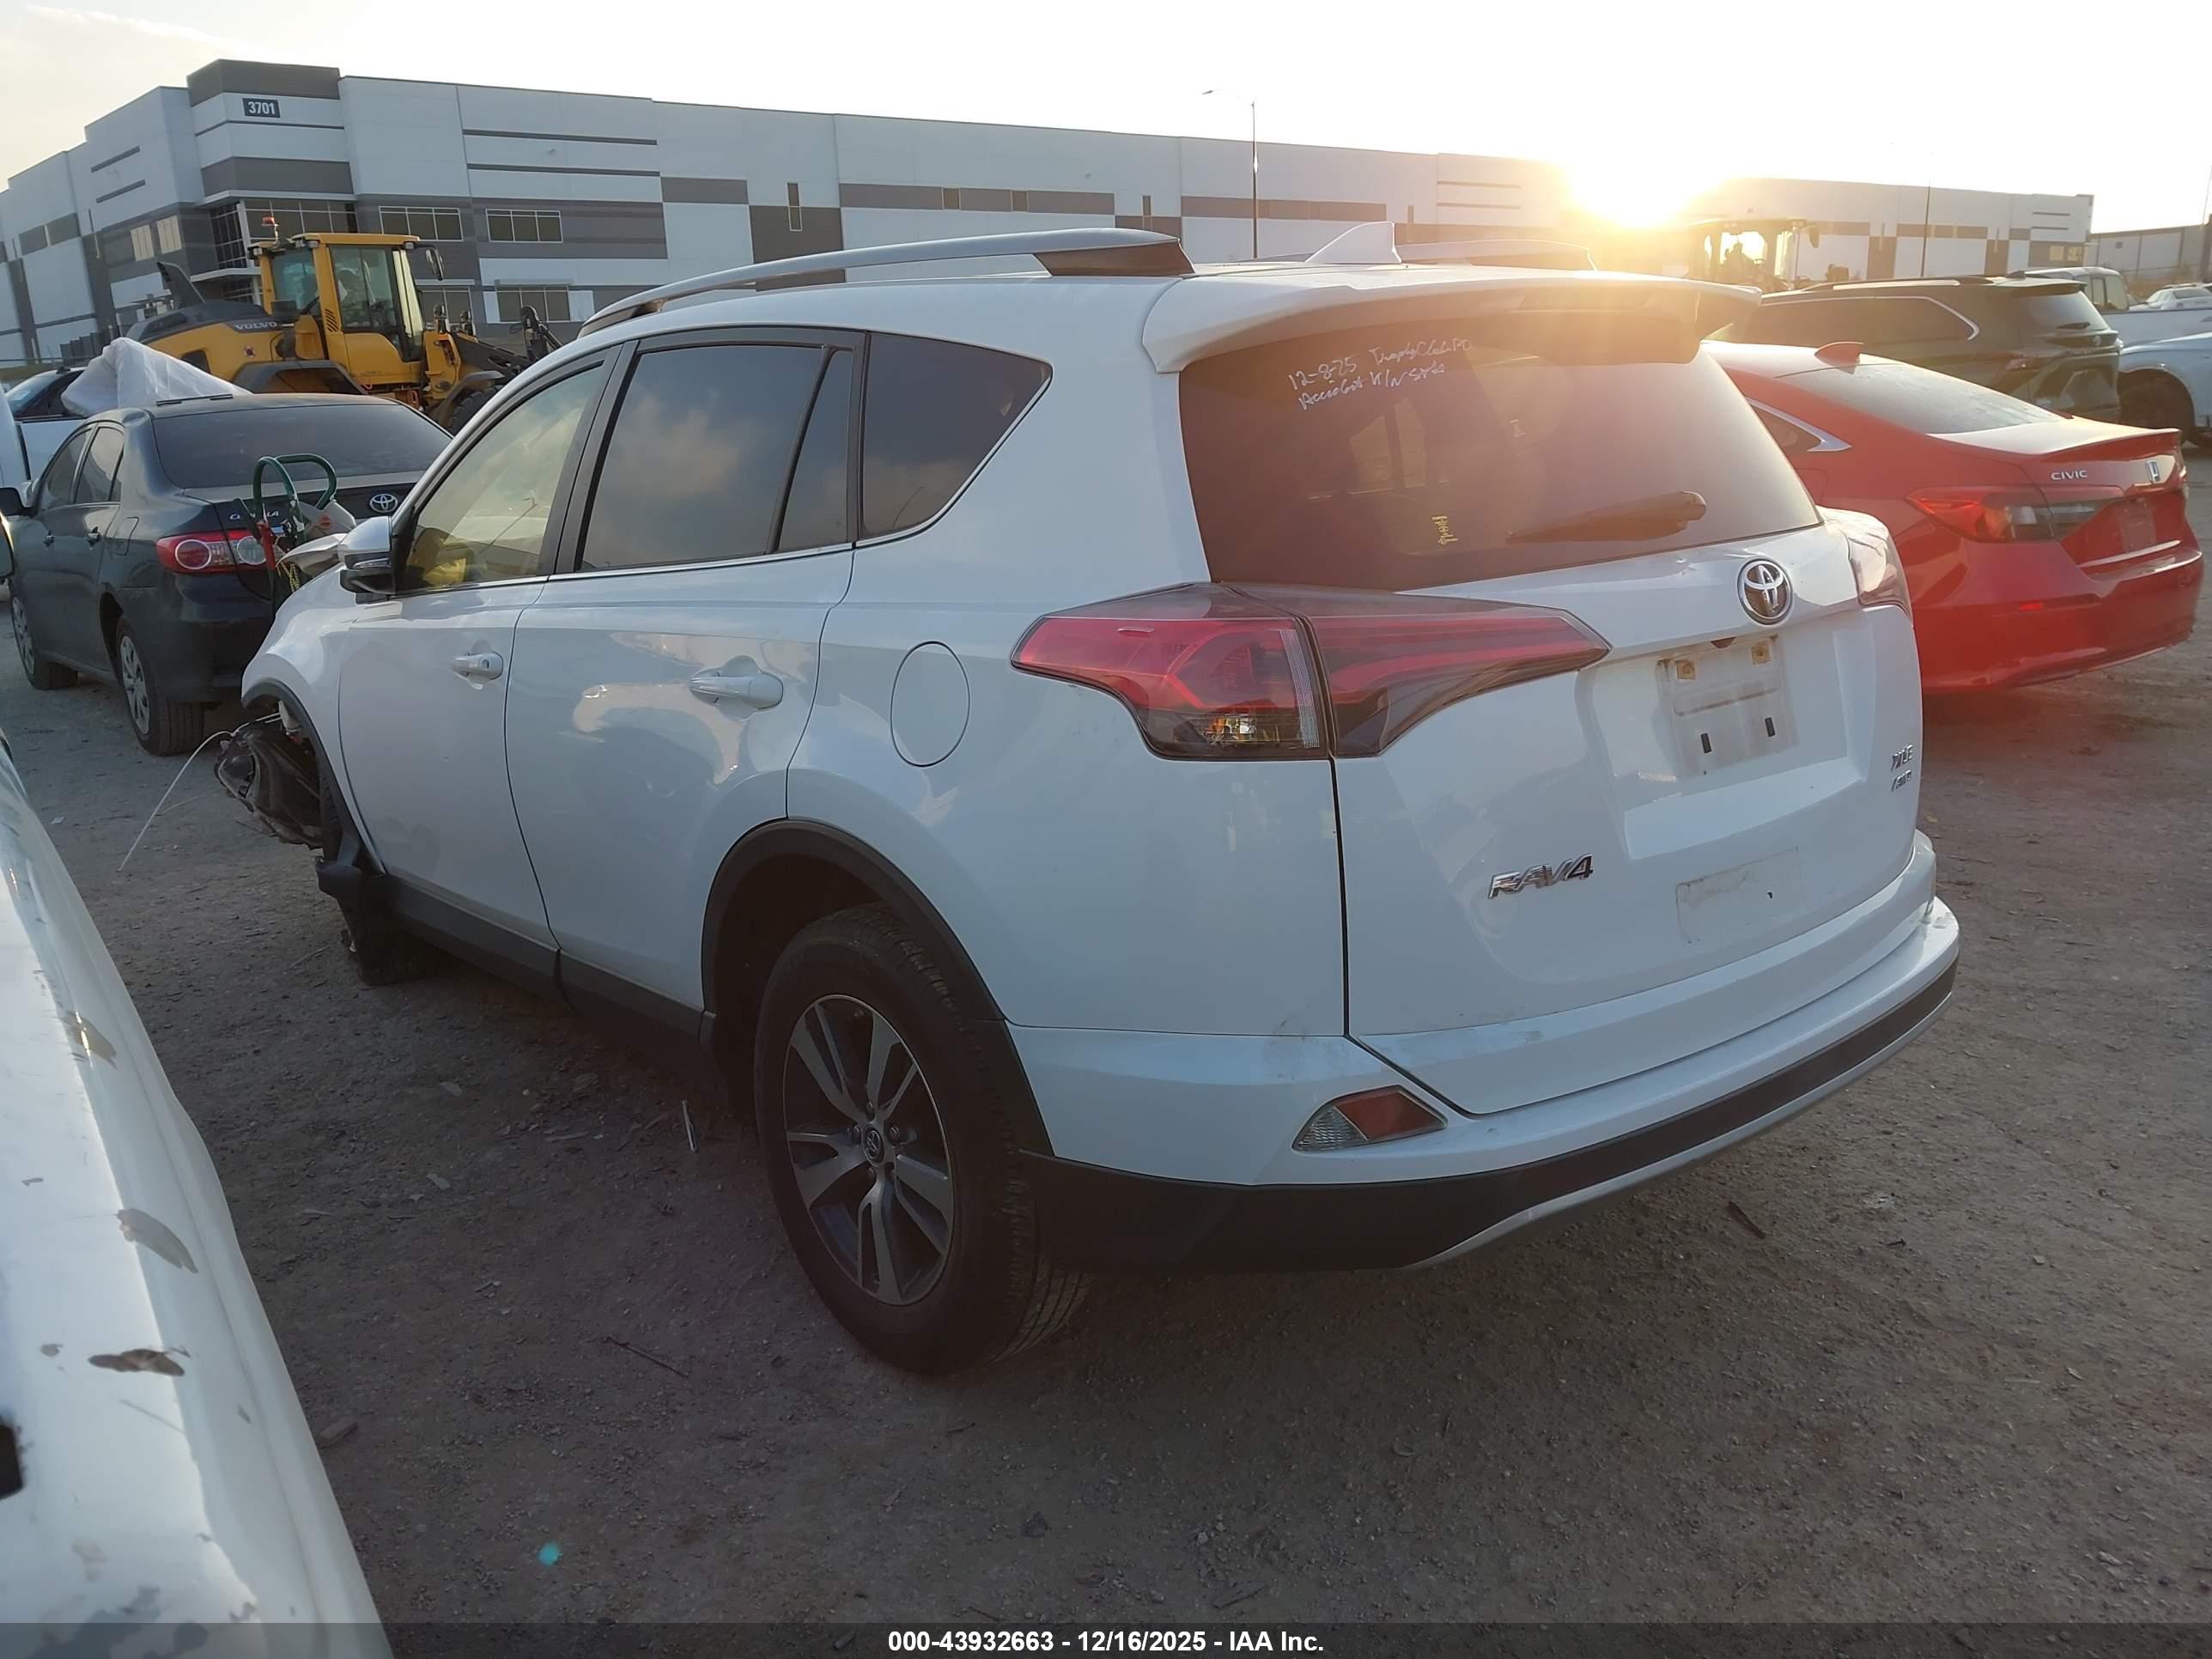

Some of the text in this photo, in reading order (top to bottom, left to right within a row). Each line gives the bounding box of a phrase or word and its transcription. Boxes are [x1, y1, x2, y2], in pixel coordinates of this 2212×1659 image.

[248, 101, 276, 115] 3701
[234, 321, 277, 330] VOLVO
[2051, 470, 2088, 480] CIVIC
[1890, 744, 1914, 772] XLE
[1488, 853, 1594, 899] RAV4
